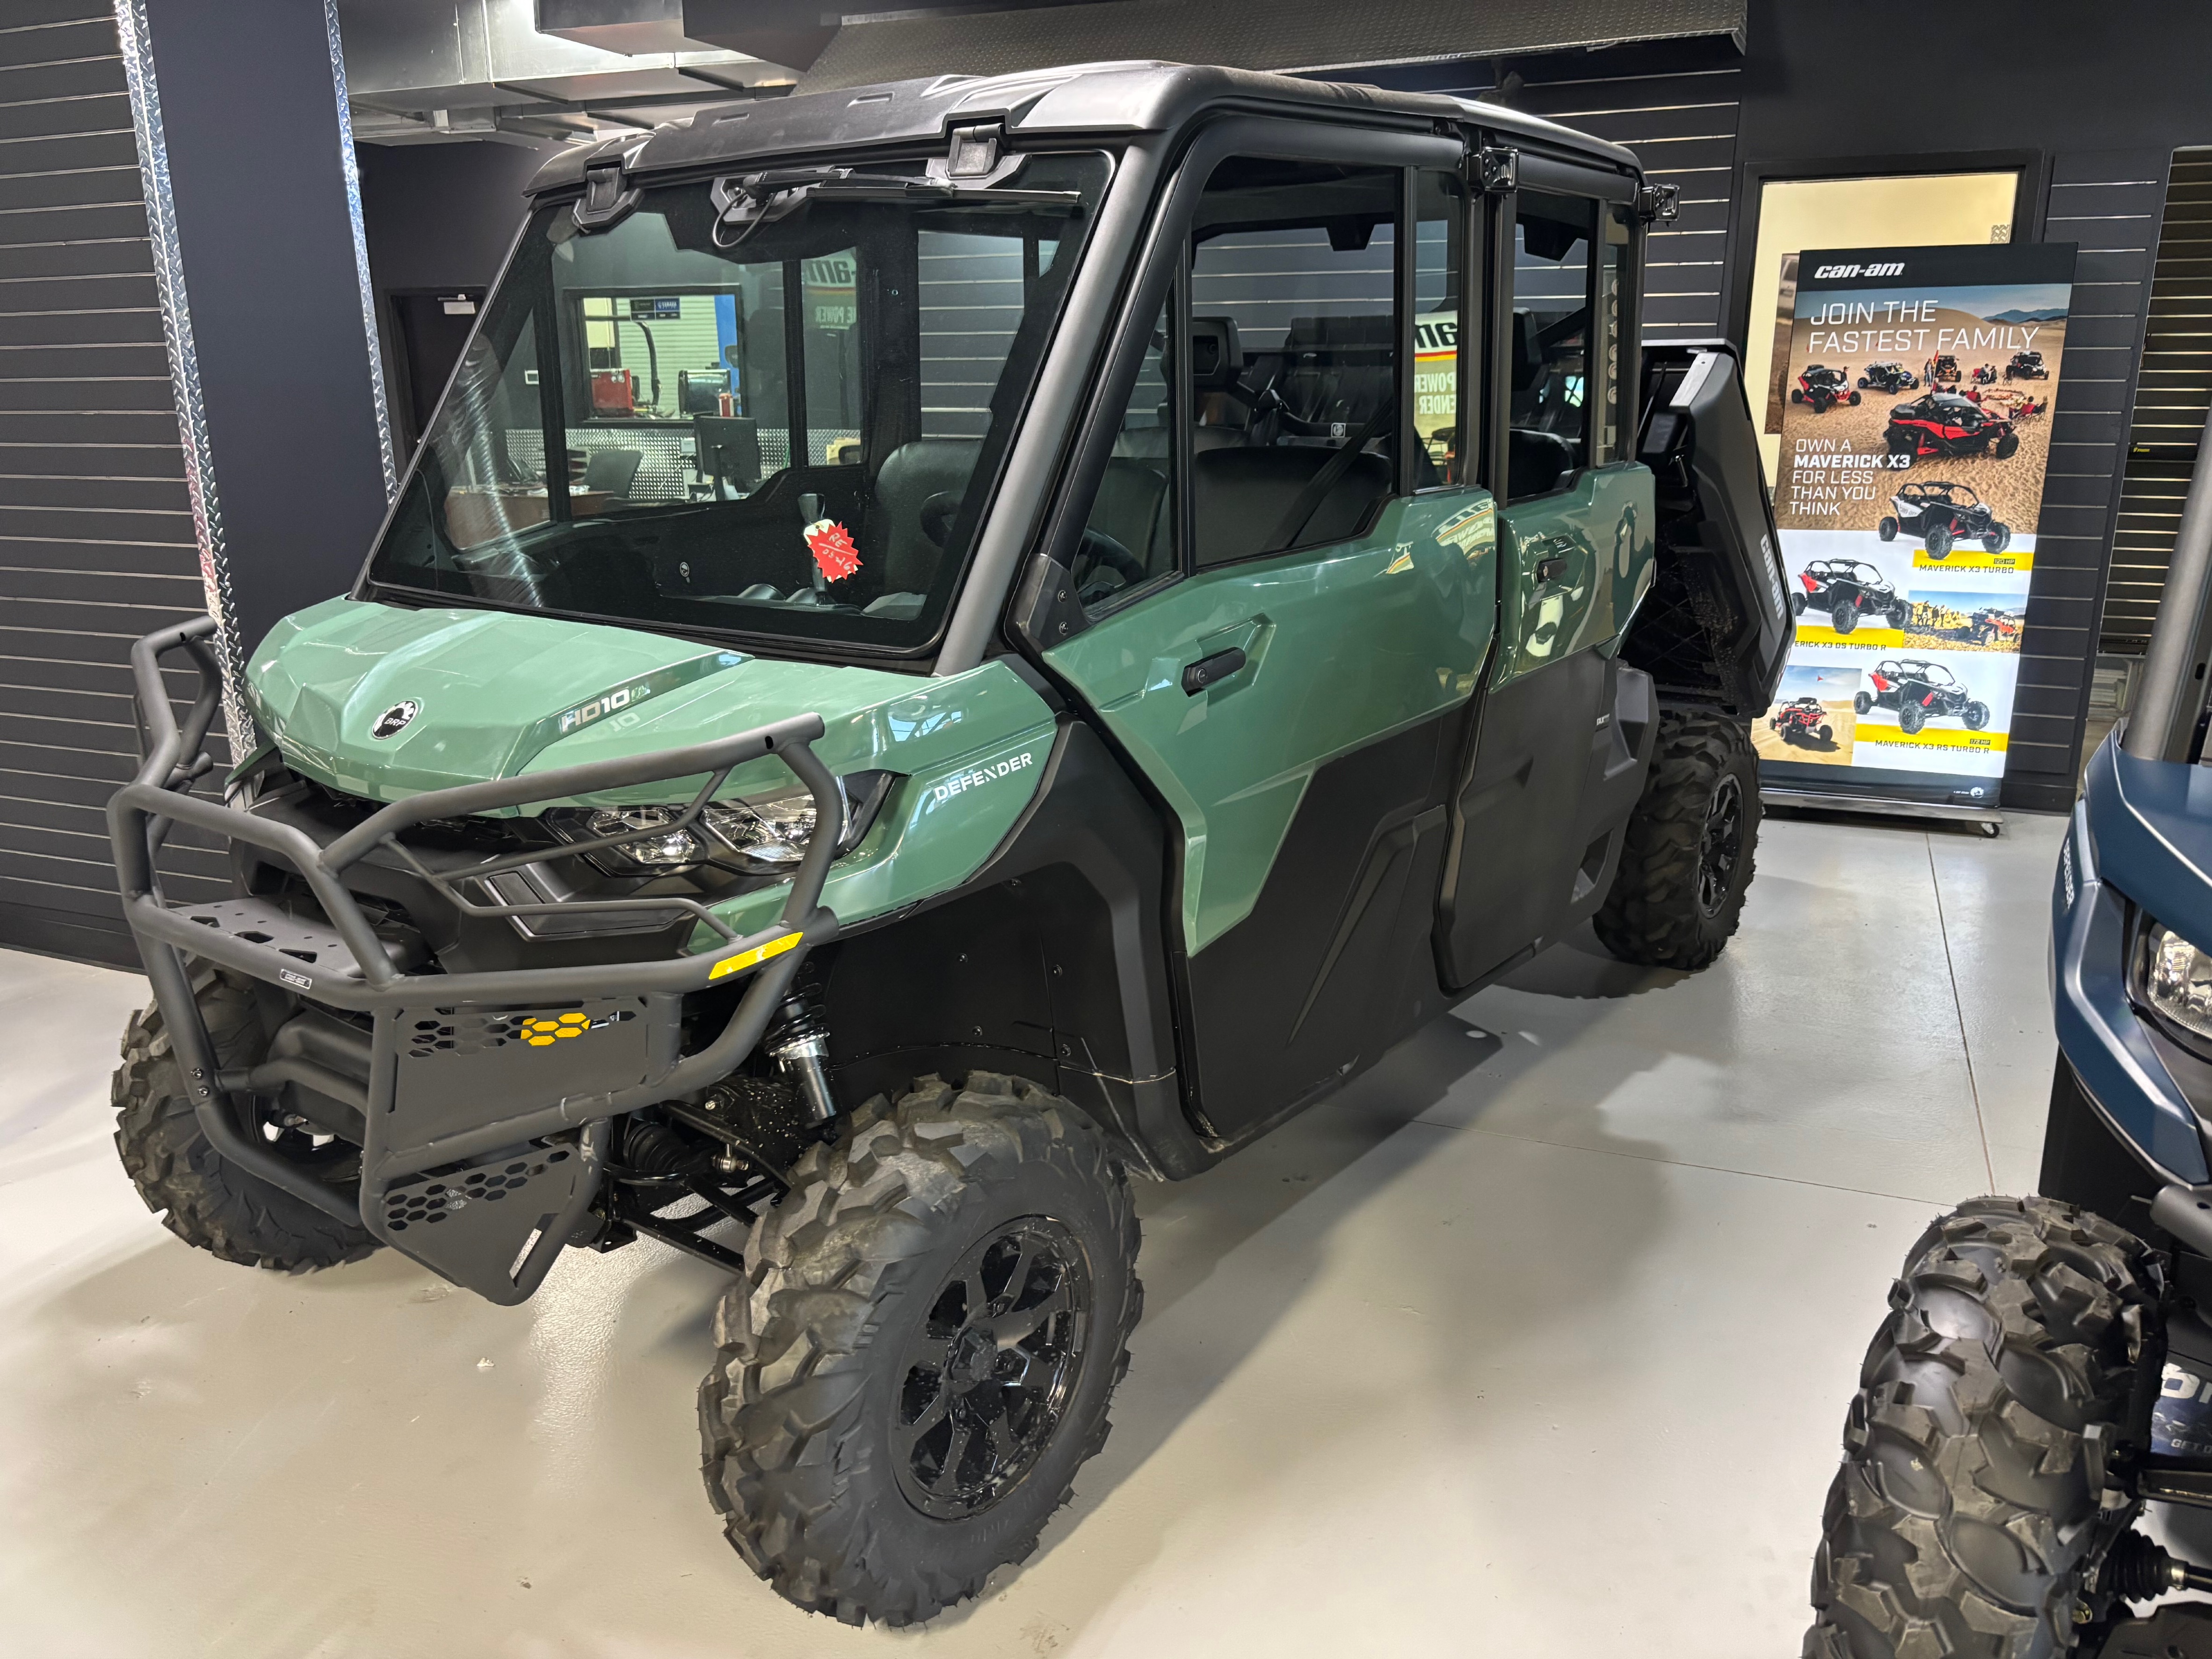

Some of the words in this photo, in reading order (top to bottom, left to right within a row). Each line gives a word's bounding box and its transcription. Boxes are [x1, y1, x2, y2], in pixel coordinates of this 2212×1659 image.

[1814, 263, 1905, 278] can-am
[1810, 302, 1875, 325] JOIN
[1884, 300, 1939, 323] THE
[1809, 329, 1930, 353] FASTEST
[1937, 327, 2039, 351] FAMILY
[1796, 439, 1836, 452] OWN
[1840, 439, 1852, 452] A
[1794, 454, 1884, 468] MAVERICK
[1887, 454, 1911, 468] X3
[1792, 470, 1826, 484] FOR
[1830, 470, 1874, 484] LESS
[1791, 486, 1837, 500] THAN
[1842, 486, 1876, 500] YOU
[1790, 502, 1842, 515] THINK
[1760, 534, 1784, 620] can-am
[561, 689, 630, 733] HD10
[384, 717, 406, 727] BRP
[1875, 740, 1921, 749] MAVERICK
[935, 752, 1033, 801] DEFENDER
